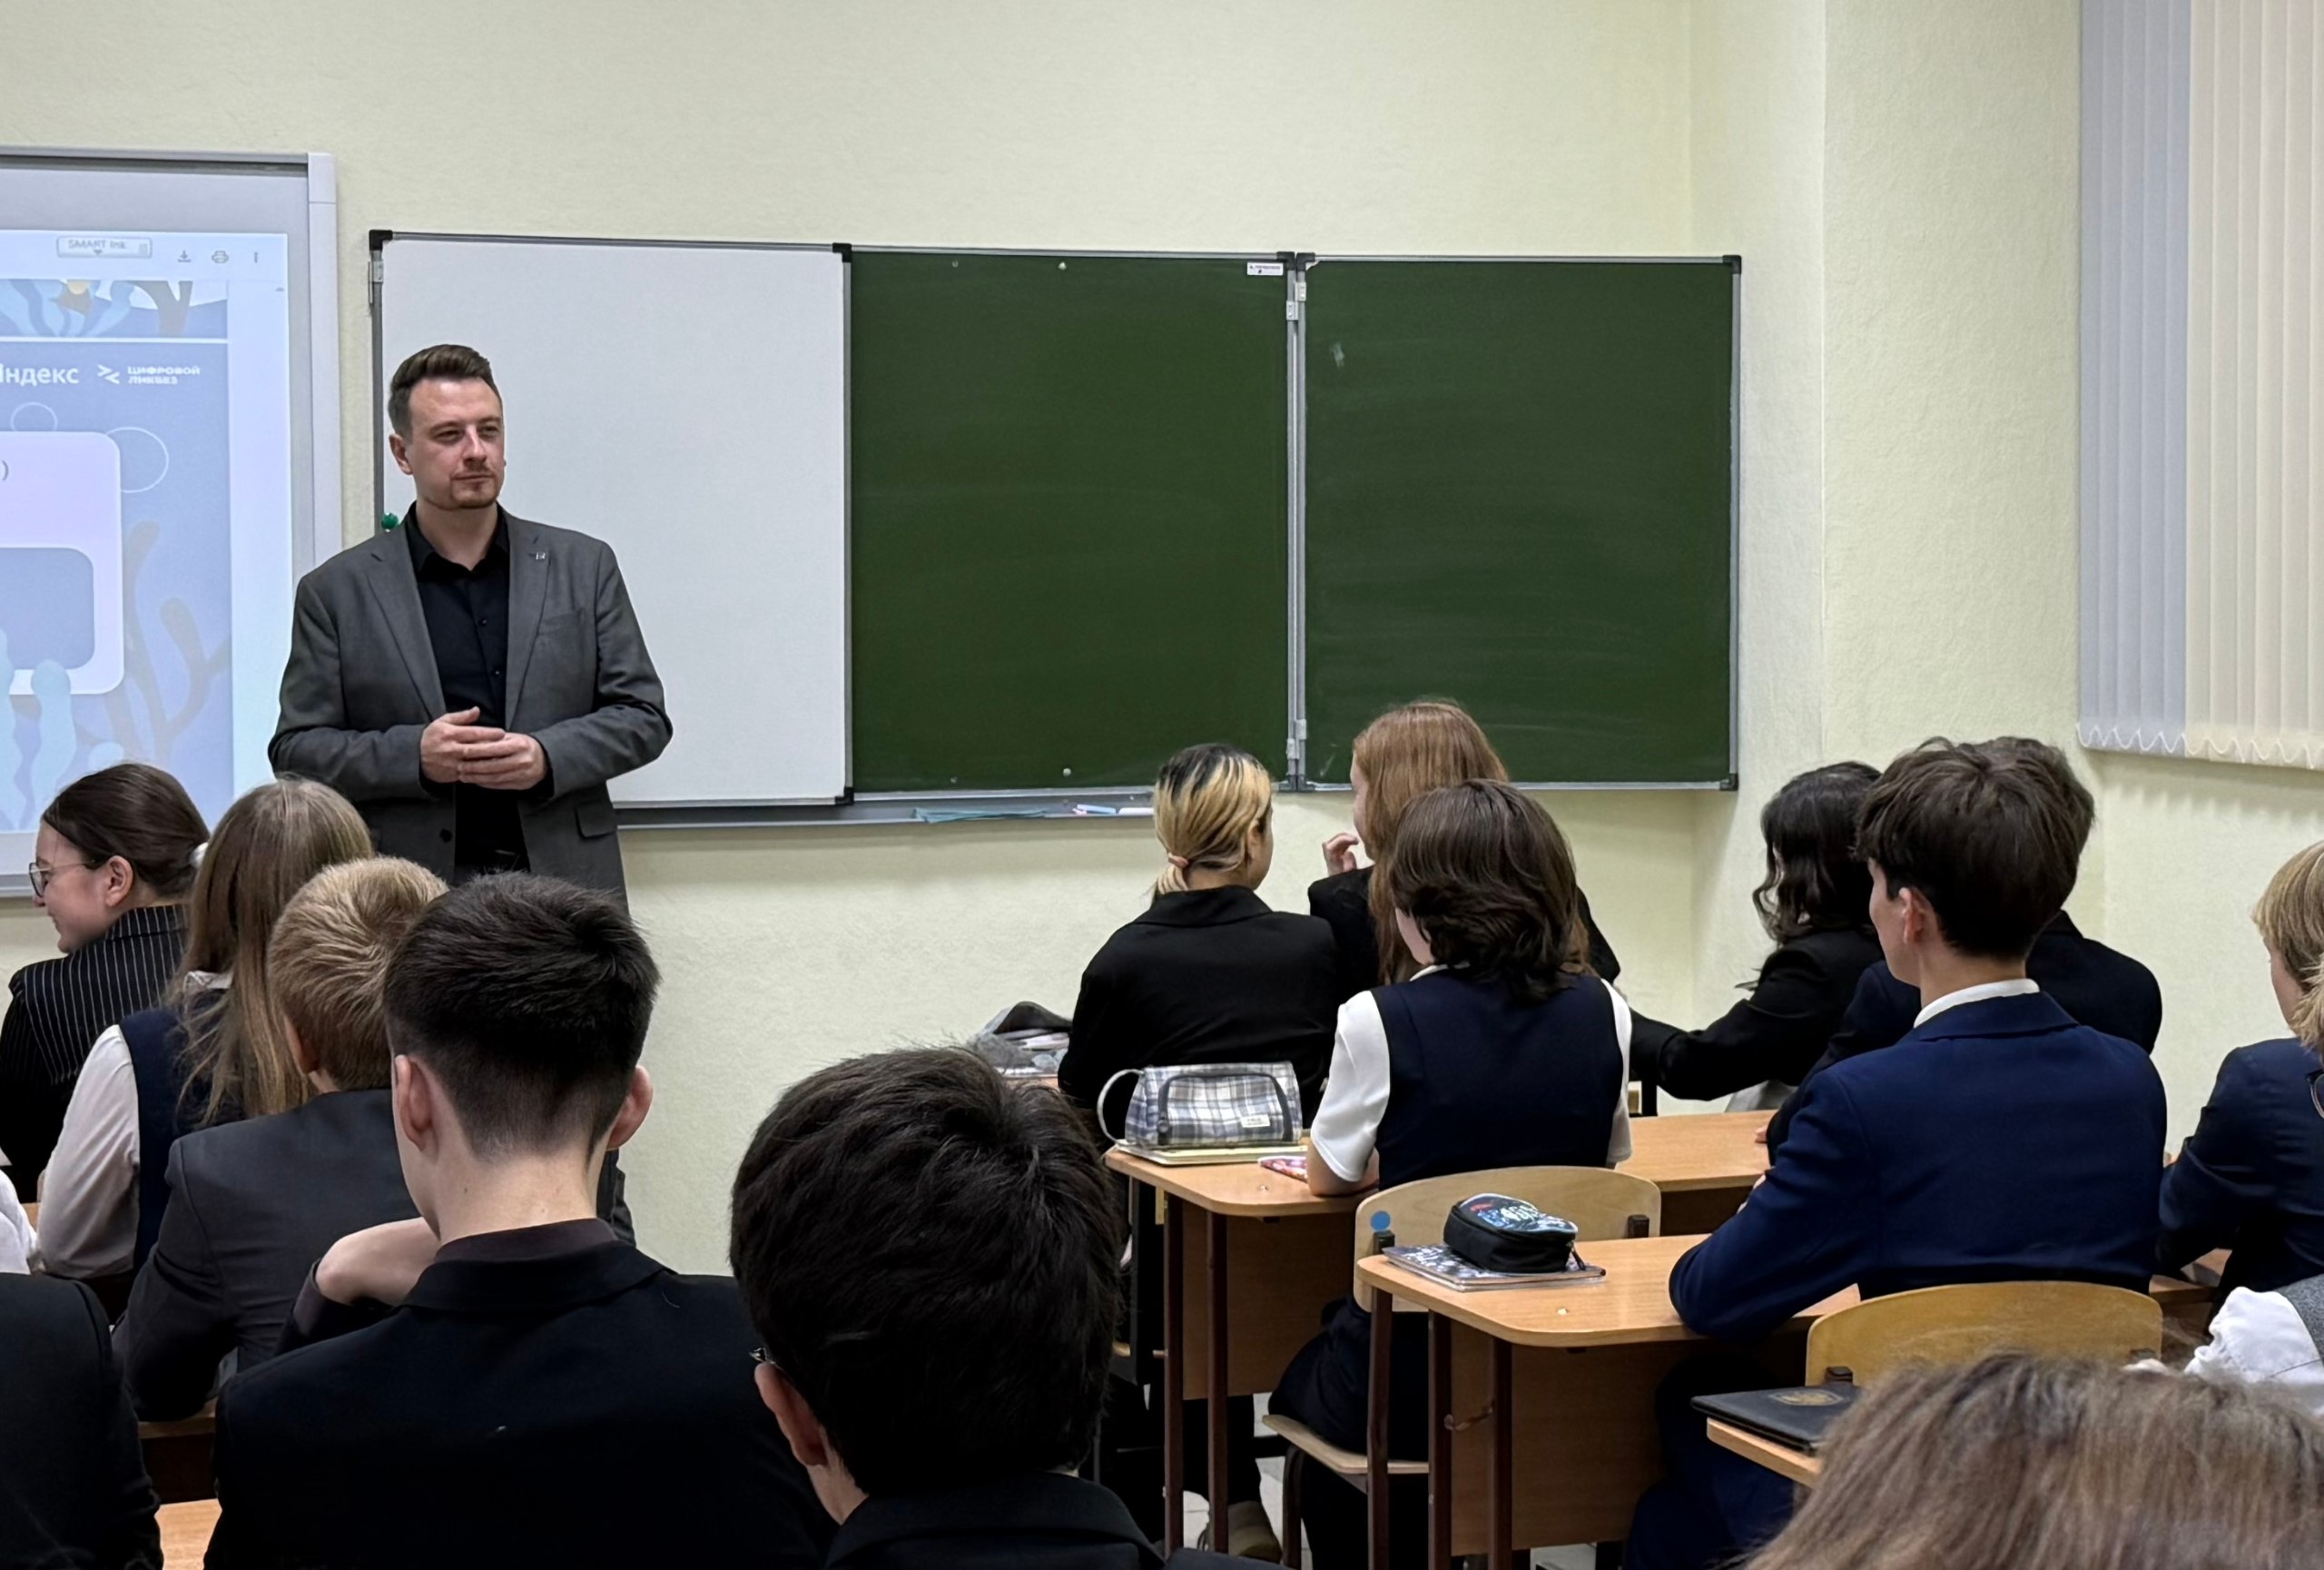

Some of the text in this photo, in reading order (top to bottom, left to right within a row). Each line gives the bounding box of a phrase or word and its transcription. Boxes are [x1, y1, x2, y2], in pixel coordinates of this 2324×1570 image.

[68, 239, 106, 249] SMART
[0, 363, 79, 387] ндекс
[127, 365, 201, 375] ЦИФРОВОЙ
